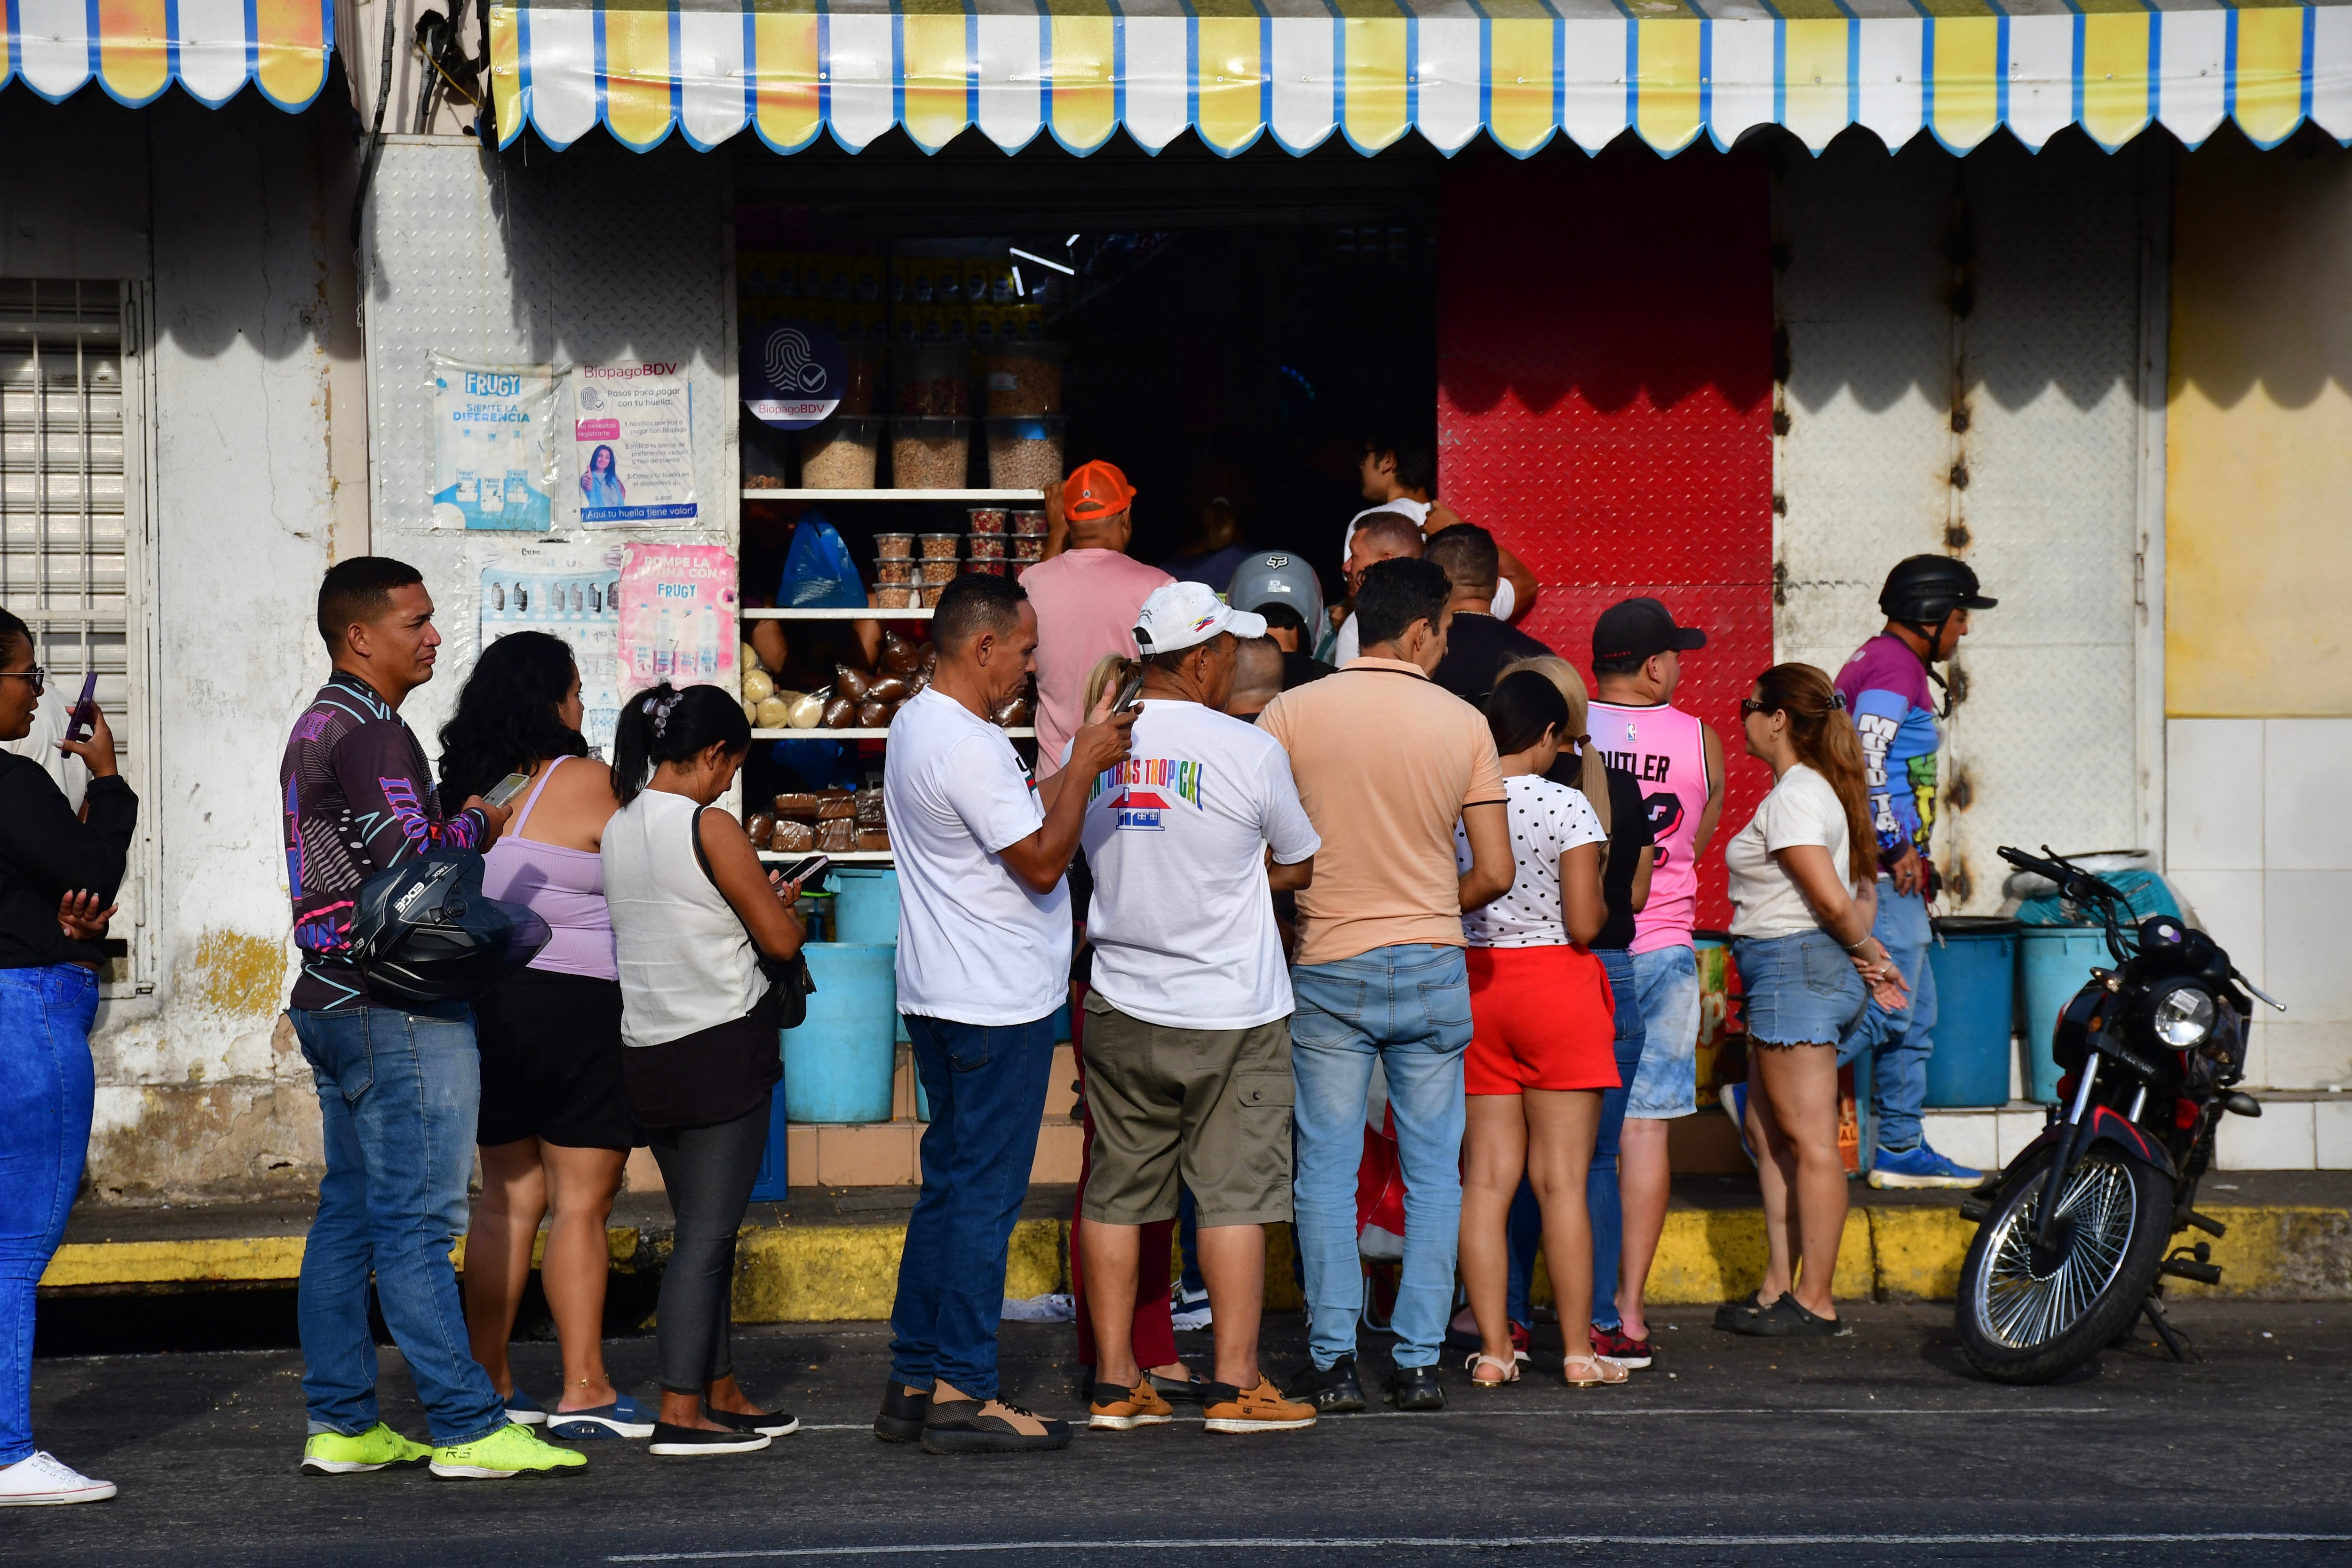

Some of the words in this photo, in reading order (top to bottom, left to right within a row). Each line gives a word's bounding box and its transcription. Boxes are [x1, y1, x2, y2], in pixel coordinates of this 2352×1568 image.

[584, 363, 677, 380] BiopagoBDV
[466, 373, 519, 396] FRUGY
[467, 404, 502, 412] SIENTE
[759, 404, 825, 415] BiopagoBDV
[453, 412, 530, 422] DIFERENCIA
[619, 508, 644, 517] huella
[647, 508, 667, 517] tiene
[644, 556, 690, 567] ROMPE
[693, 557, 710, 568] LA
[689, 568, 717, 579] CON
[658, 583, 696, 598] FRUGY
[1145, 758, 1203, 812] TROPICAL
[395, 882, 424, 914] EDGE
[2122, 1050, 2155, 1075] KEEWAY
[445, 1447, 472, 1459] RS
